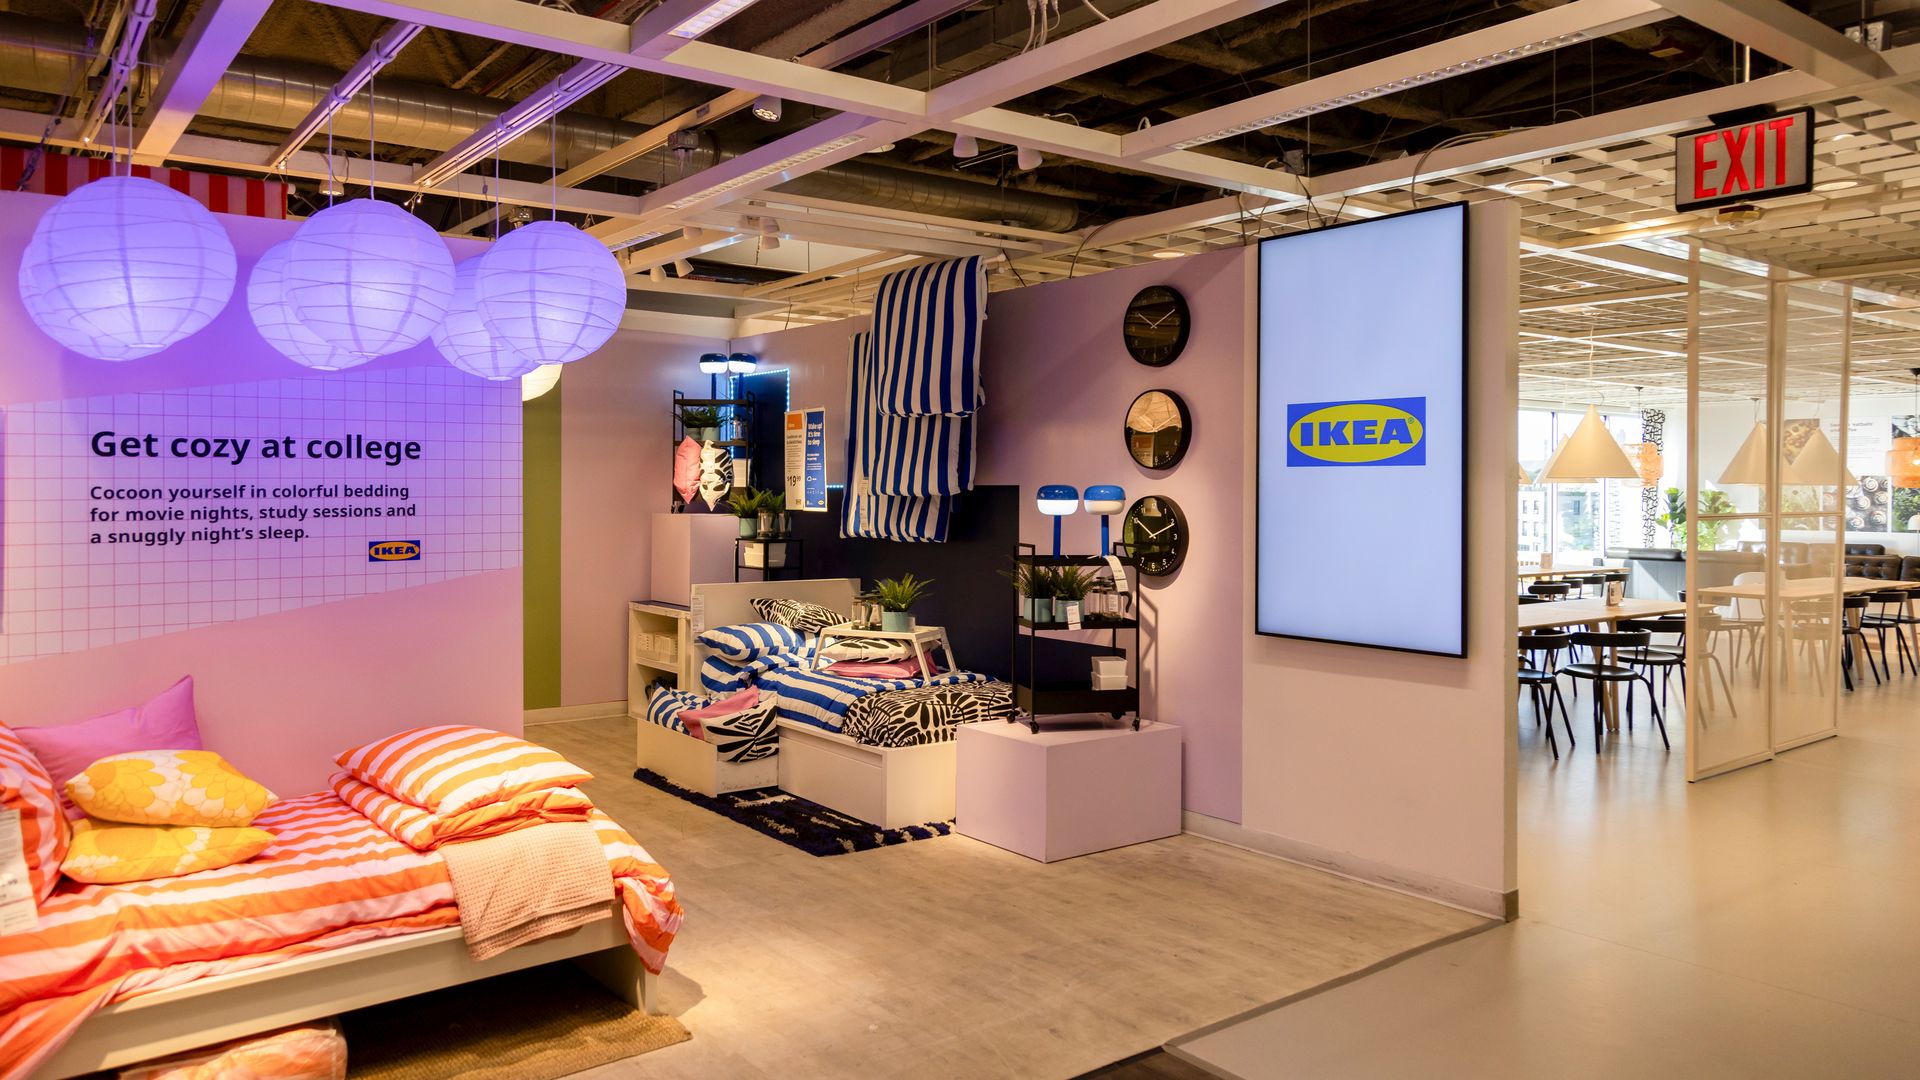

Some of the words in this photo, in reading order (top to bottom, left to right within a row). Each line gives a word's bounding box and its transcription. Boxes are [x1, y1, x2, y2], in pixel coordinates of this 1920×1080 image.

[1694, 117, 1794, 199] EXIT
[1300, 418, 1413, 447] IKEA
[91, 431, 159, 458] Get
[170, 437, 251, 464] cozy
[261, 436, 297, 460] at
[307, 434, 422, 467] college
[90, 486, 162, 500] Cocoon
[168, 485, 246, 503] yourself
[250, 485, 267, 498] in
[272, 484, 338, 498] colorful
[344, 484, 409, 501] bedding
[90, 507, 119, 522] for
[126, 508, 185, 521] movie
[190, 506, 254, 524] nights,
[259, 505, 312, 521] study
[313, 505, 382, 518] sessions
[386, 503, 416, 517] and
[90, 533, 101, 544] a
[108, 527, 186, 546] snuggly
[191, 525, 254, 545] night's
[259, 525, 310, 543] sleep.
[374, 545, 417, 557] IKEA
